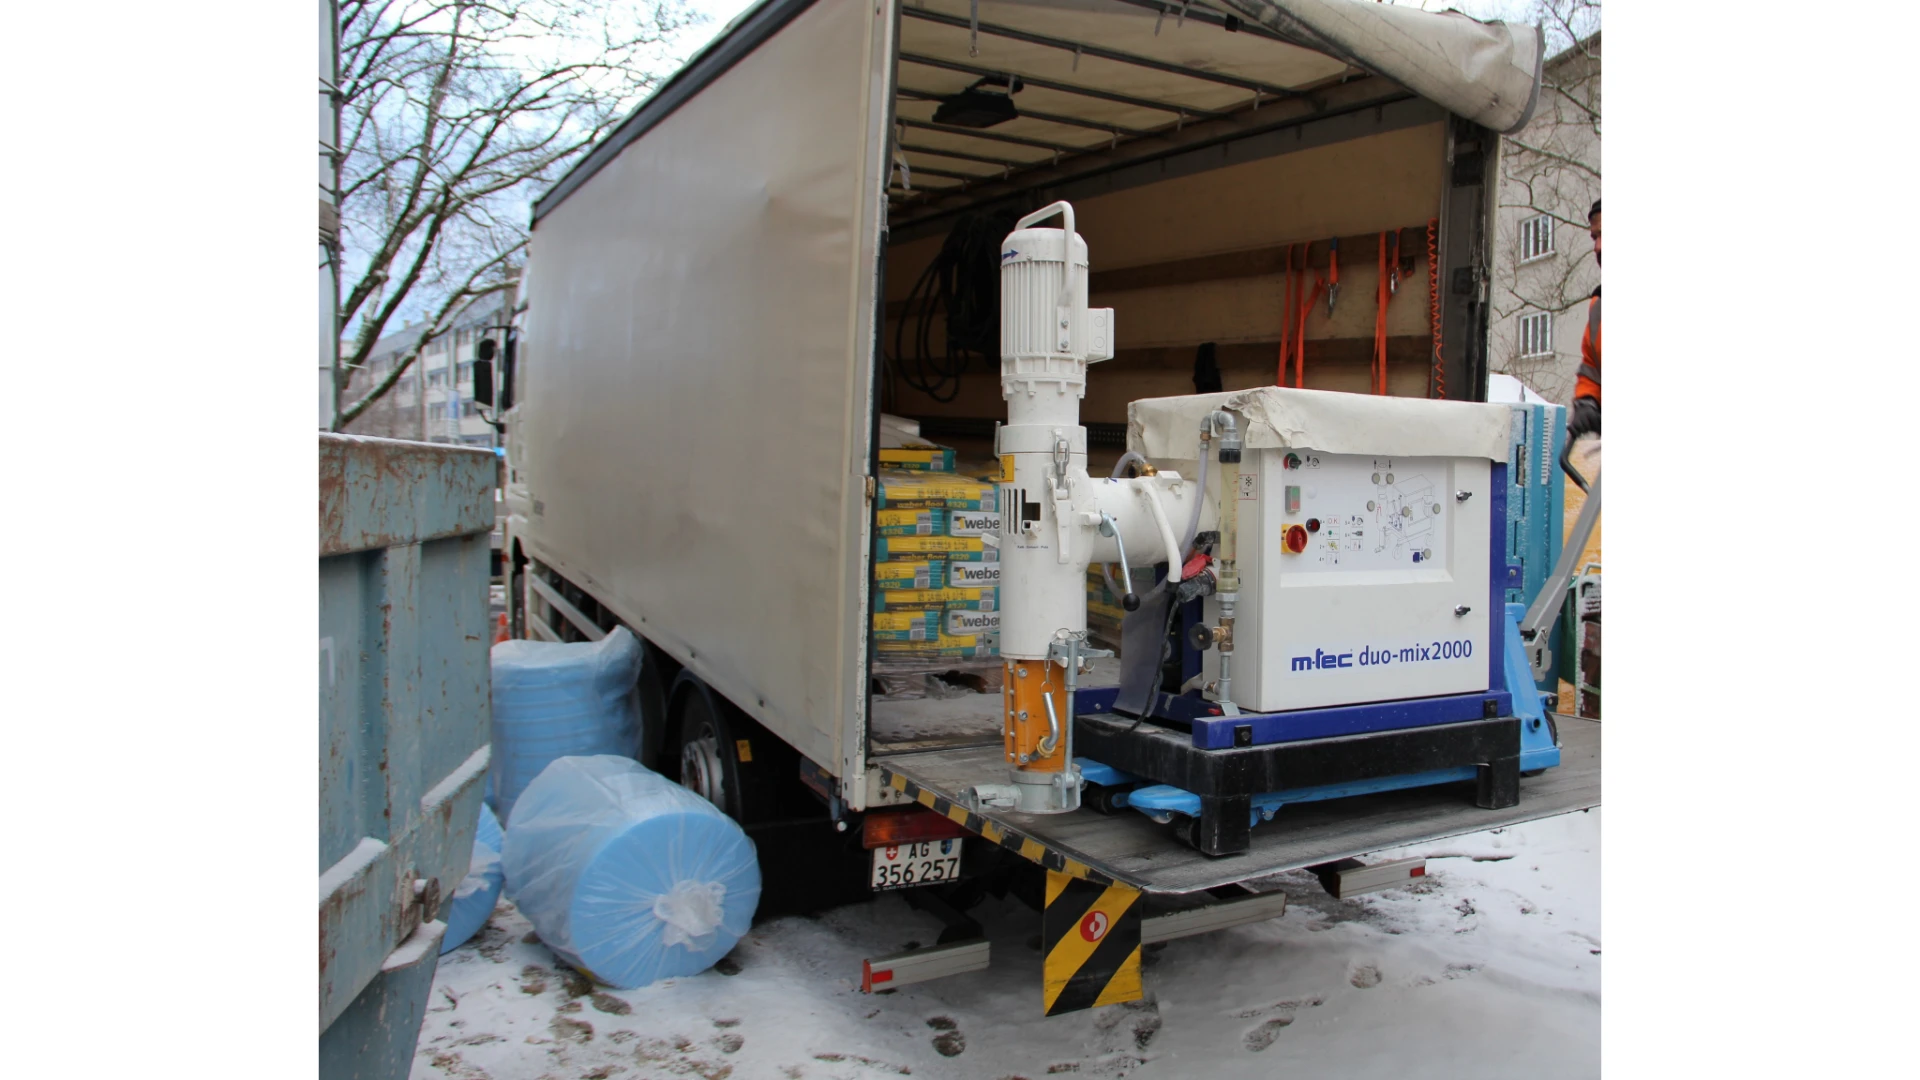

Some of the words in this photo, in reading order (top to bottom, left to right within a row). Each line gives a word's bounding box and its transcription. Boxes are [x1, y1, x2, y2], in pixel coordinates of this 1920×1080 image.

[964, 516, 1000, 530] webe
[964, 566, 1000, 580] webe
[908, 841, 930, 859] AG
[876, 862, 915, 887] 356
[920, 858, 958, 881] 257
